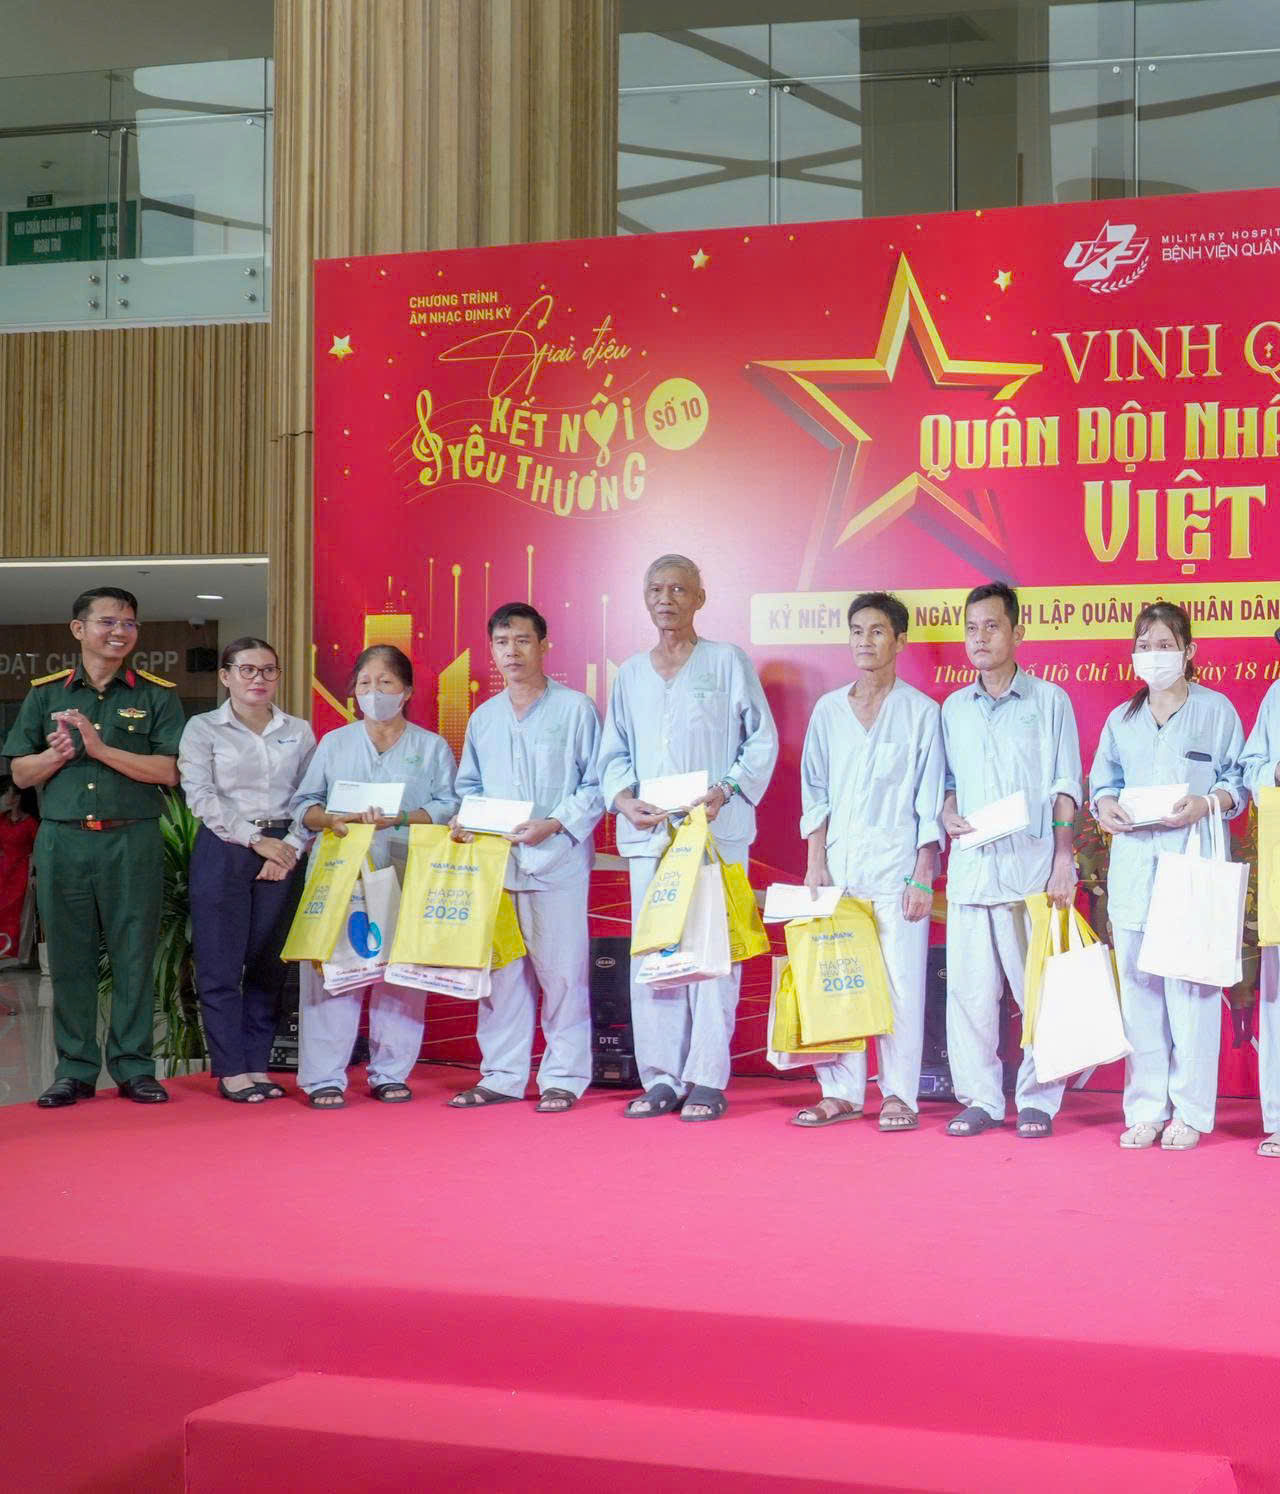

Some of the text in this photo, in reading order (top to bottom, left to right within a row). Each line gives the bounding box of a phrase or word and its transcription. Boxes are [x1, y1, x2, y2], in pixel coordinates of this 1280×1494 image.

[1161, 232, 1226, 244] MILITARY
[1161, 243, 1203, 263] BỆNH
[1205, 242, 1239, 261] VIỆN
[409, 289, 498, 308] CHƯƠNG TRÌNH
[409, 311, 427, 325] ÂM
[429, 310, 462, 326] NHẠC
[464, 308, 494, 324] ĐỊNH
[582, 315, 632, 369] điệu
[1051, 323, 1223, 384] VINH
[489, 395, 548, 449] KẾT
[652, 395, 702, 431] SỐ 10
[919, 405, 1061, 481] QUÂN
[1076, 399, 1167, 473] ĐỘI
[514, 451, 647, 517] THƯƠNG
[1082, 468, 1268, 575] VIỆT
[799, 603, 841, 635] NIỆM
[915, 602, 963, 627] NGÀY
[1039, 599, 1075, 631] LẬP
[1082, 597, 1133, 626] QUÂN
[1180, 595, 1233, 621] NHÂN
[1240, 594, 1280, 620] DÂN
[131, 650, 179, 673] GPP
[936, 663, 980, 684] Thàn
[1042, 663, 1069, 682] Hồ
[1075, 662, 1109, 682] Chí
[1193, 663, 1227, 683] gày
[1234, 661, 1258, 681] 18
[427, 887, 473, 898] HAPPY
[423, 904, 470, 921] 2026
[822, 974, 866, 993] 2026
[599, 1036, 620, 1045] DTE
